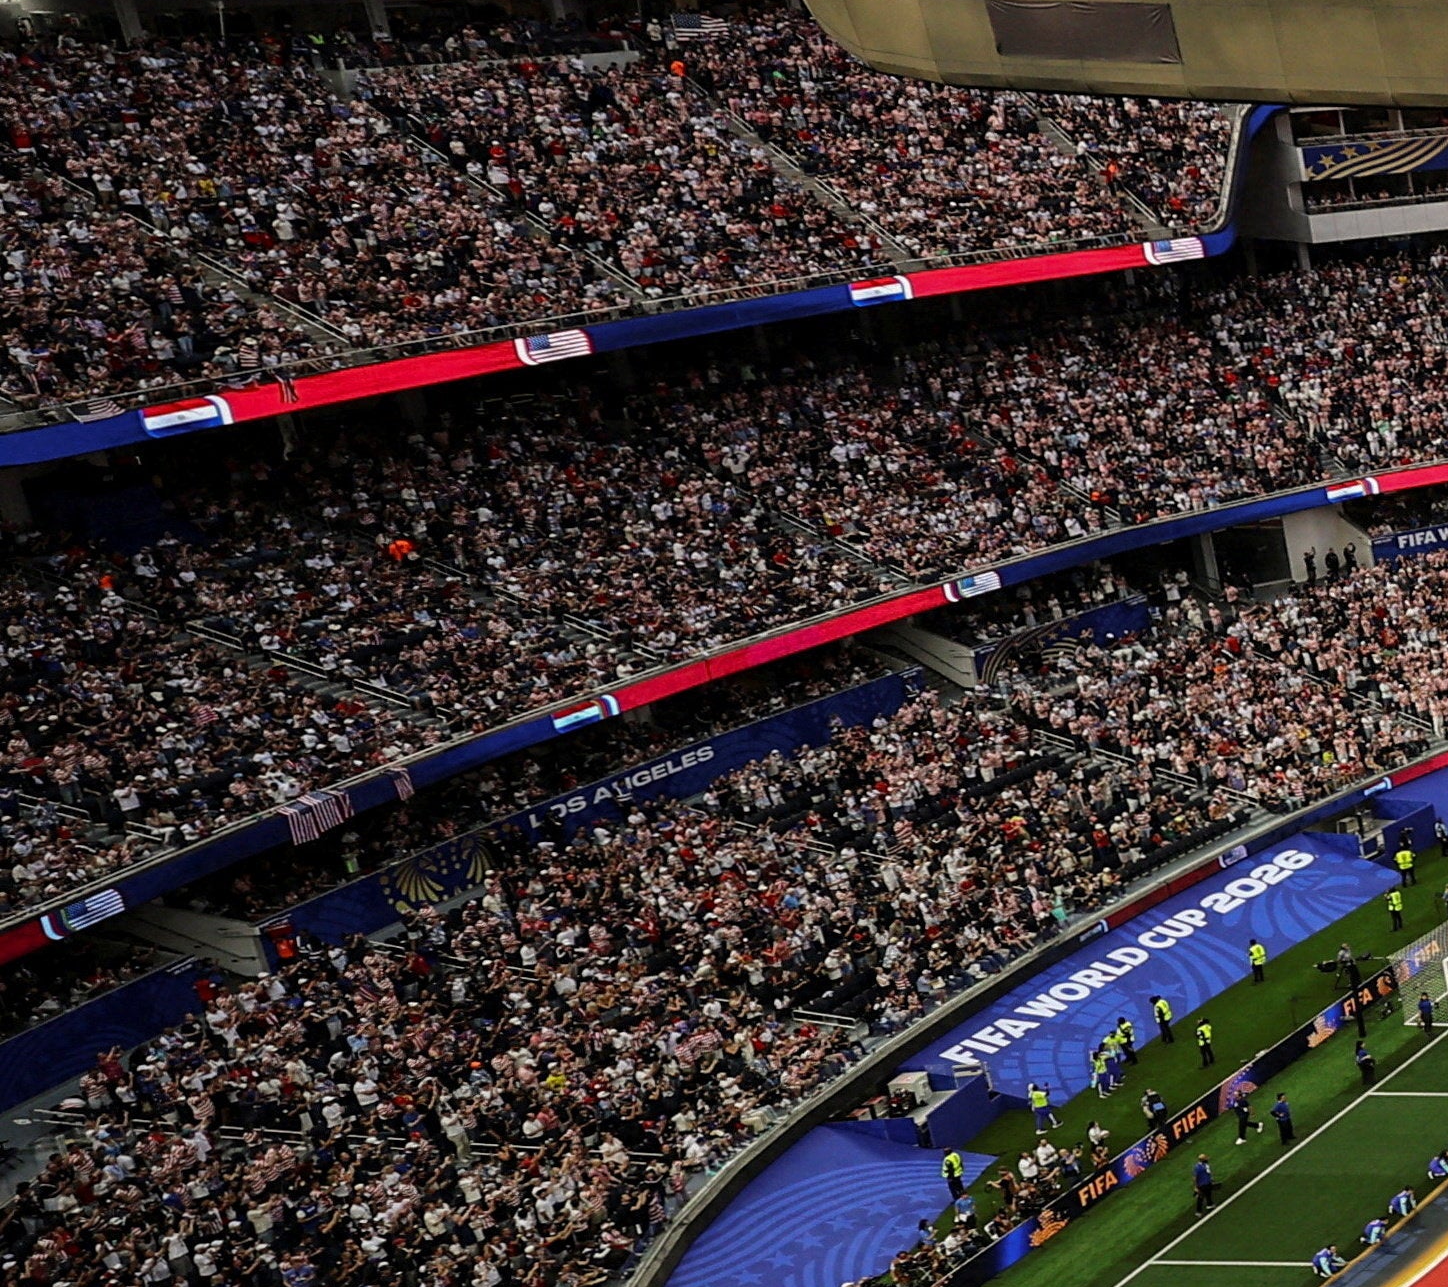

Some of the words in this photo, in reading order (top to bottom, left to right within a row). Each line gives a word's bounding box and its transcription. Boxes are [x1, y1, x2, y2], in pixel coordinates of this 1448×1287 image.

[1397, 531, 1438, 549] FIFA
[940, 1016, 1041, 1066] FIFA
[1015, 946, 1150, 1018] WORLD
[1138, 909, 1210, 949] CUP
[1200, 849, 1315, 914] 2026
[1172, 1105, 1208, 1139] FIFA
[1078, 1170, 1118, 1207] FIFA
